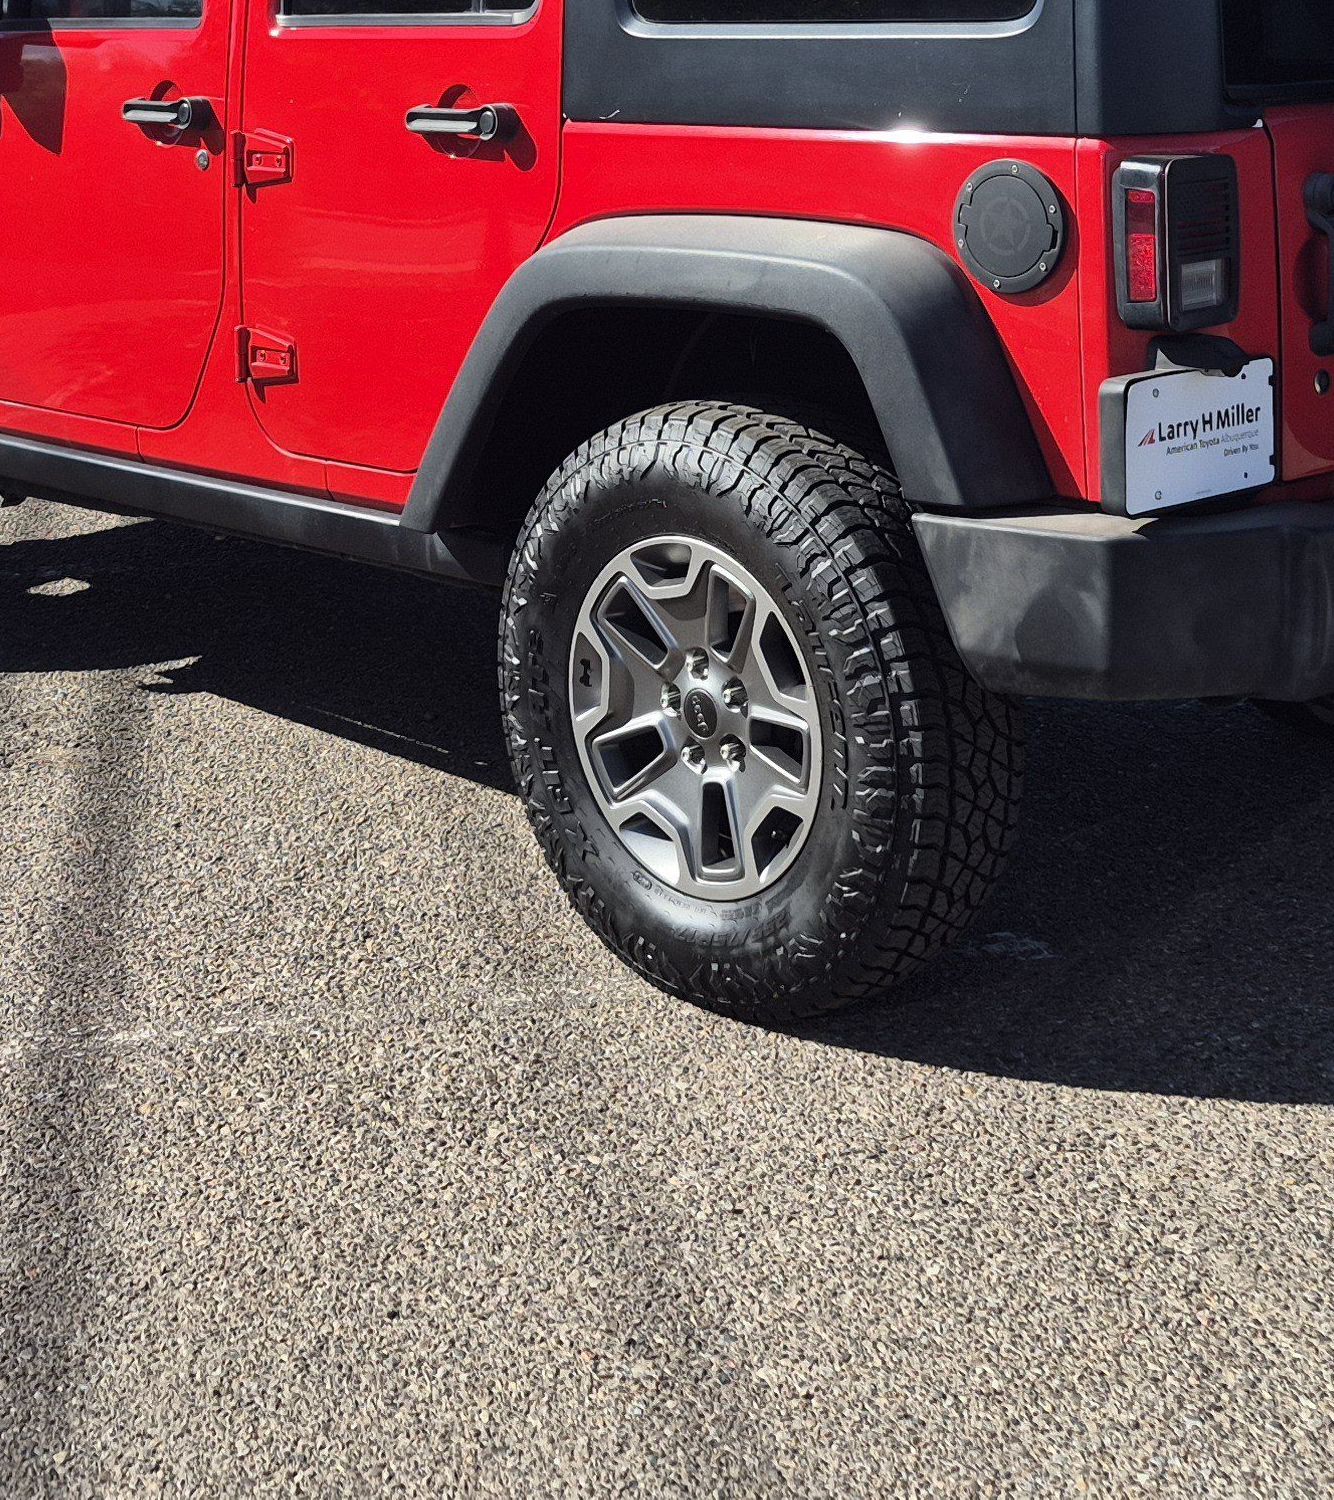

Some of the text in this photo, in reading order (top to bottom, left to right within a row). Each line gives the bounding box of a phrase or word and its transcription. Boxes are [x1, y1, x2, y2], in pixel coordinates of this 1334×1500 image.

[1158, 403, 1261, 442] Larry H Miller
[1166, 442, 1198, 456] American
[1199, 438, 1220, 450] Toyota
[1223, 446, 1241, 457] Driven
